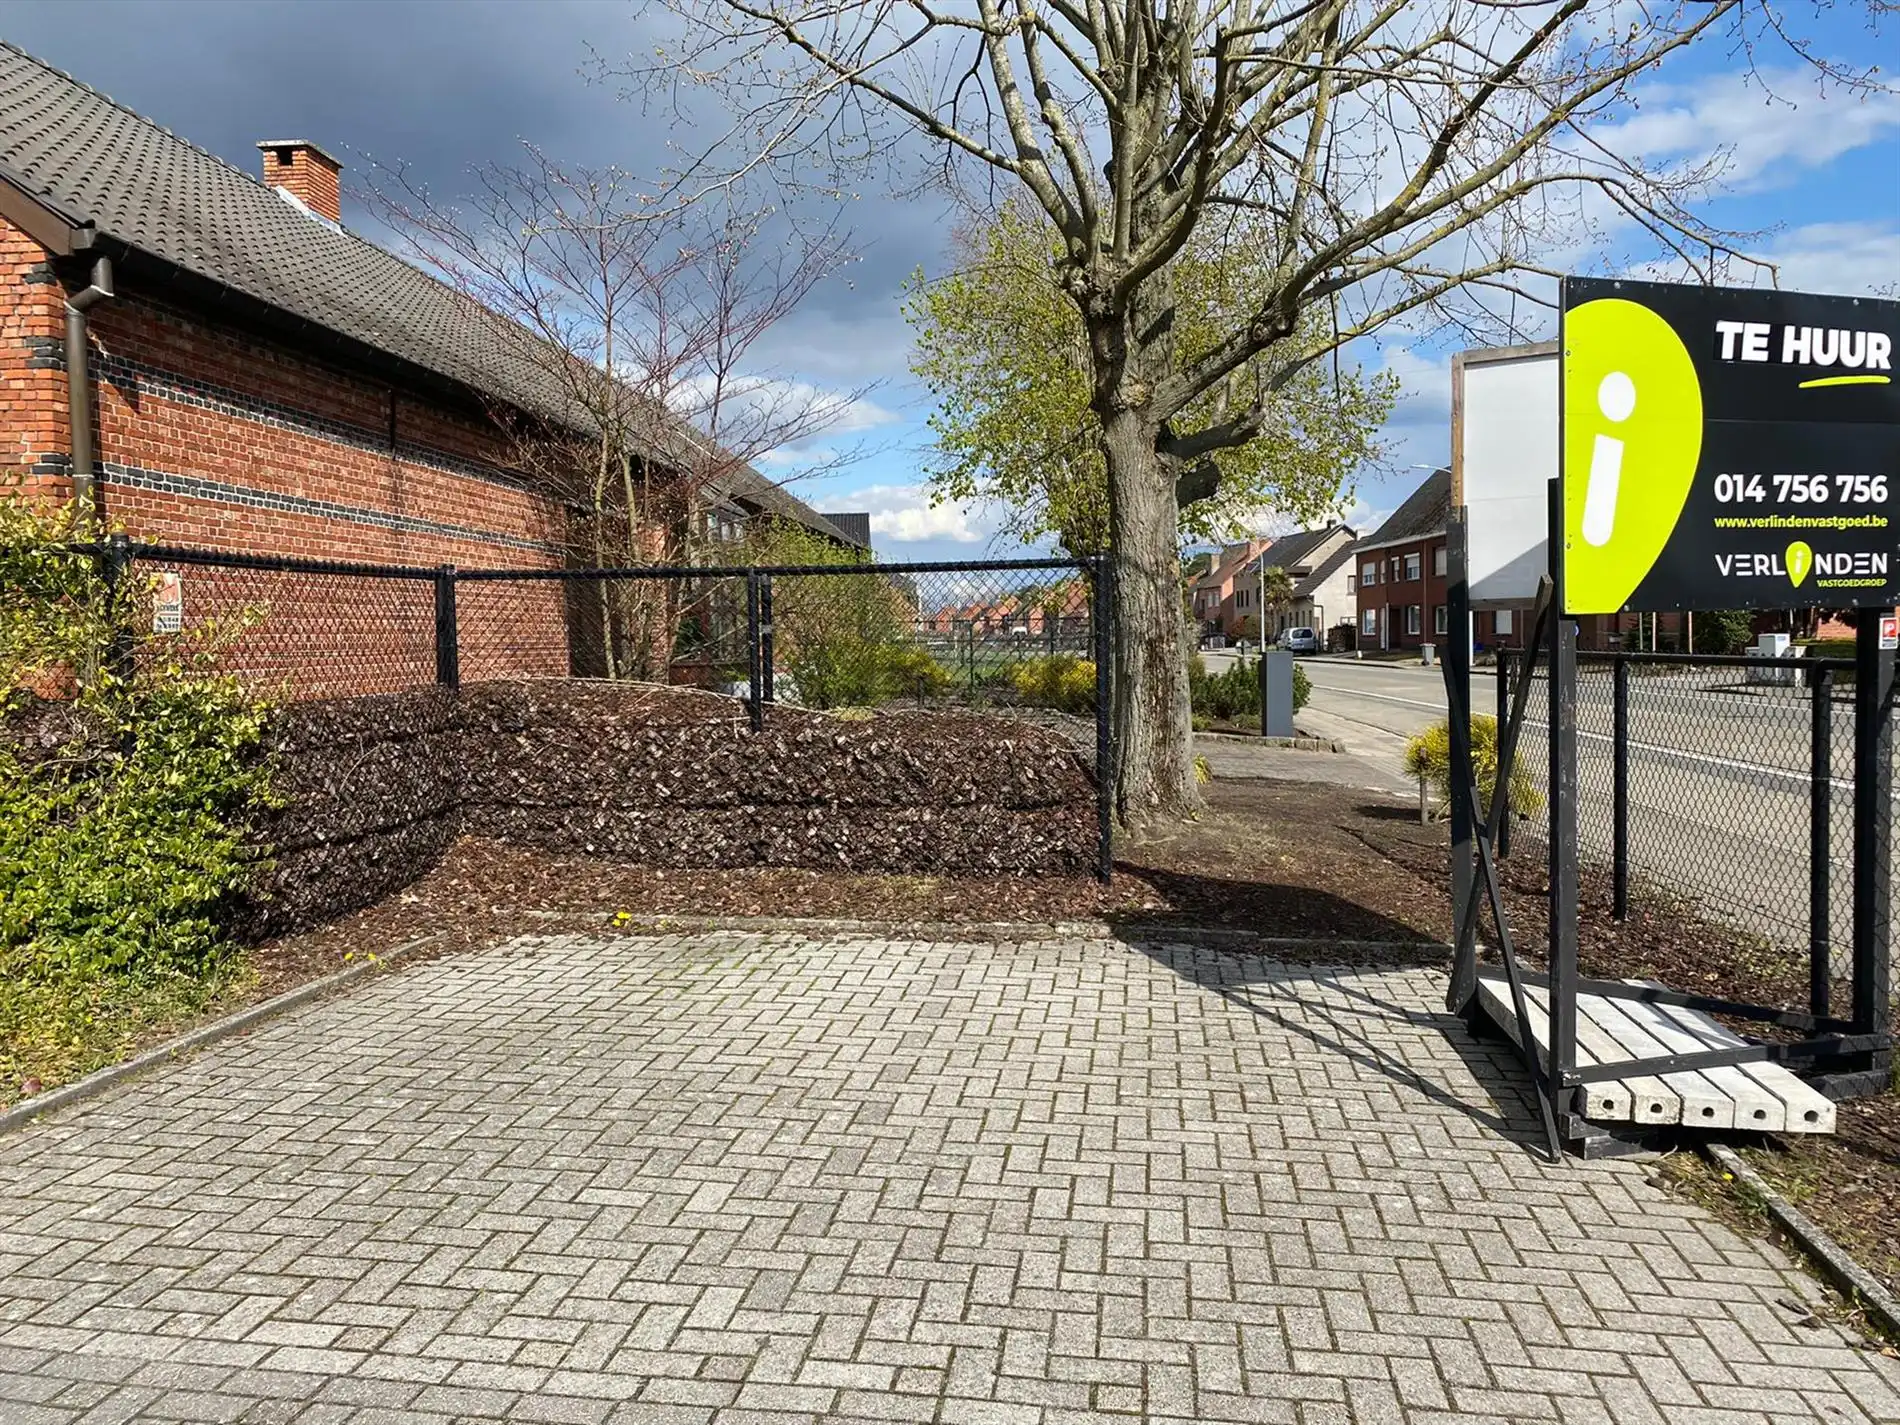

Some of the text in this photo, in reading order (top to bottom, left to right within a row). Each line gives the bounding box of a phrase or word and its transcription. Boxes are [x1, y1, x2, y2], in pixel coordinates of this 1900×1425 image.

[1715, 320, 1892, 370] TE HUUR
[1714, 473, 1889, 503] 014 756 756
[1714, 514, 1889, 530] www.verlindenvastgoed.be
[1816, 578, 1888, 588] VASTGOEDGROEP
